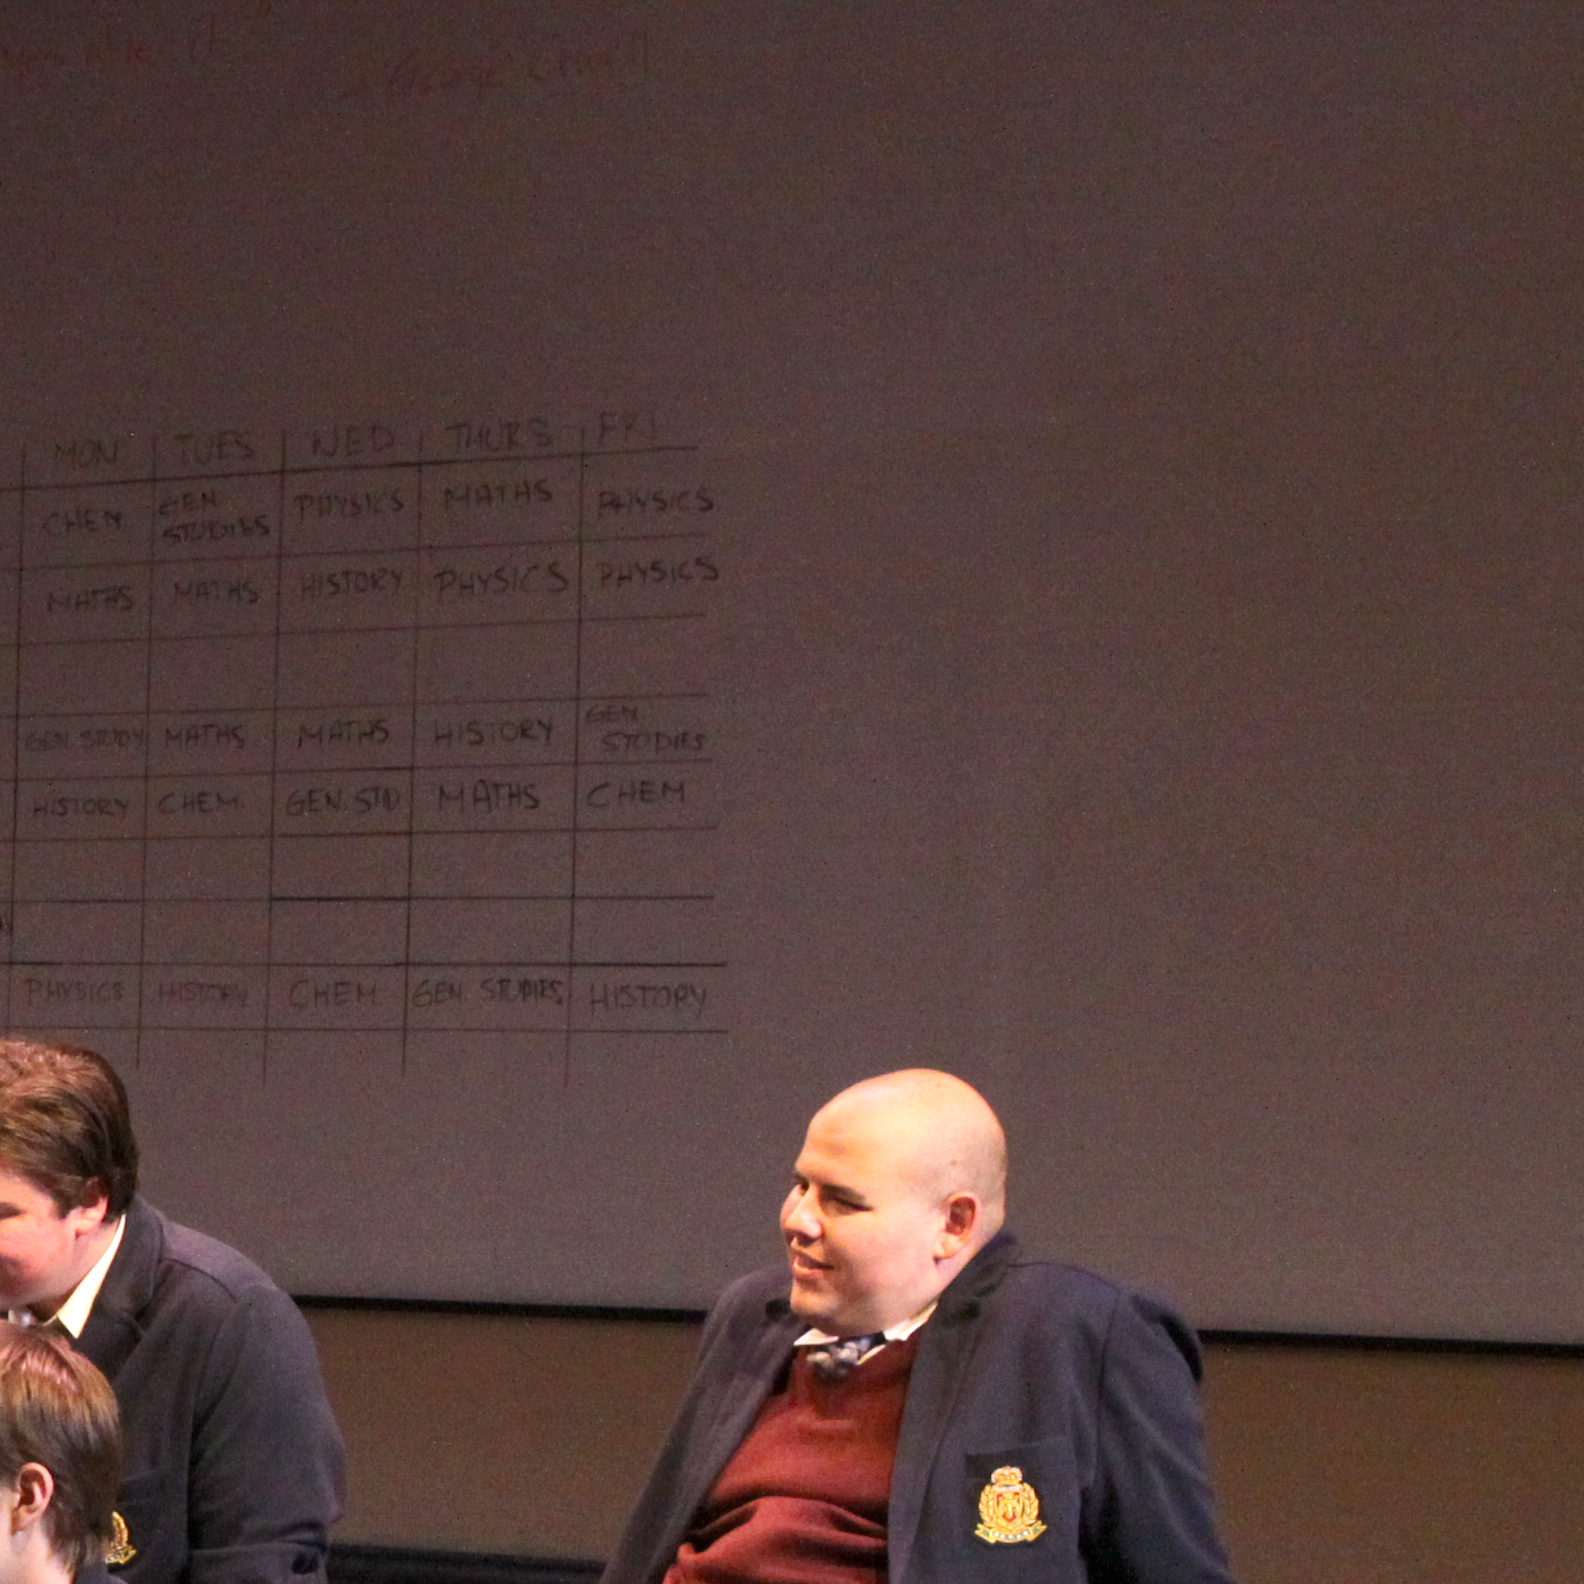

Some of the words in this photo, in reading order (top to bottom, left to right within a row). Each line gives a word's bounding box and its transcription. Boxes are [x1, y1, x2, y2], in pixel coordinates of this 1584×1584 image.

[173, 430, 258, 466] TUES
[311, 426, 397, 460] WED
[445, 418, 553, 452] THURS
[55, 440, 118, 470] MON
[293, 488, 406, 522] PHYSICS
[443, 478, 554, 509] MATHS
[597, 486, 715, 519] PHYSICS
[300, 566, 404, 600] HISTORY
[433, 561, 571, 598] PHYSICS
[596, 556, 721, 589] PHYSICS
[46, 585, 135, 614] MATHS
[172, 580, 260, 606] MATHS
[163, 722, 246, 750] MATHS
[296, 717, 391, 748] MATHS
[434, 716, 554, 747] HISTORY
[33, 797, 131, 822] HISTORY
[437, 780, 542, 812] MATHS
[585, 780, 686, 808] CHEM
[24, 976, 125, 1008] PHYSICS
[288, 977, 377, 1009] CHEM
[589, 982, 707, 1019] HISTORY
